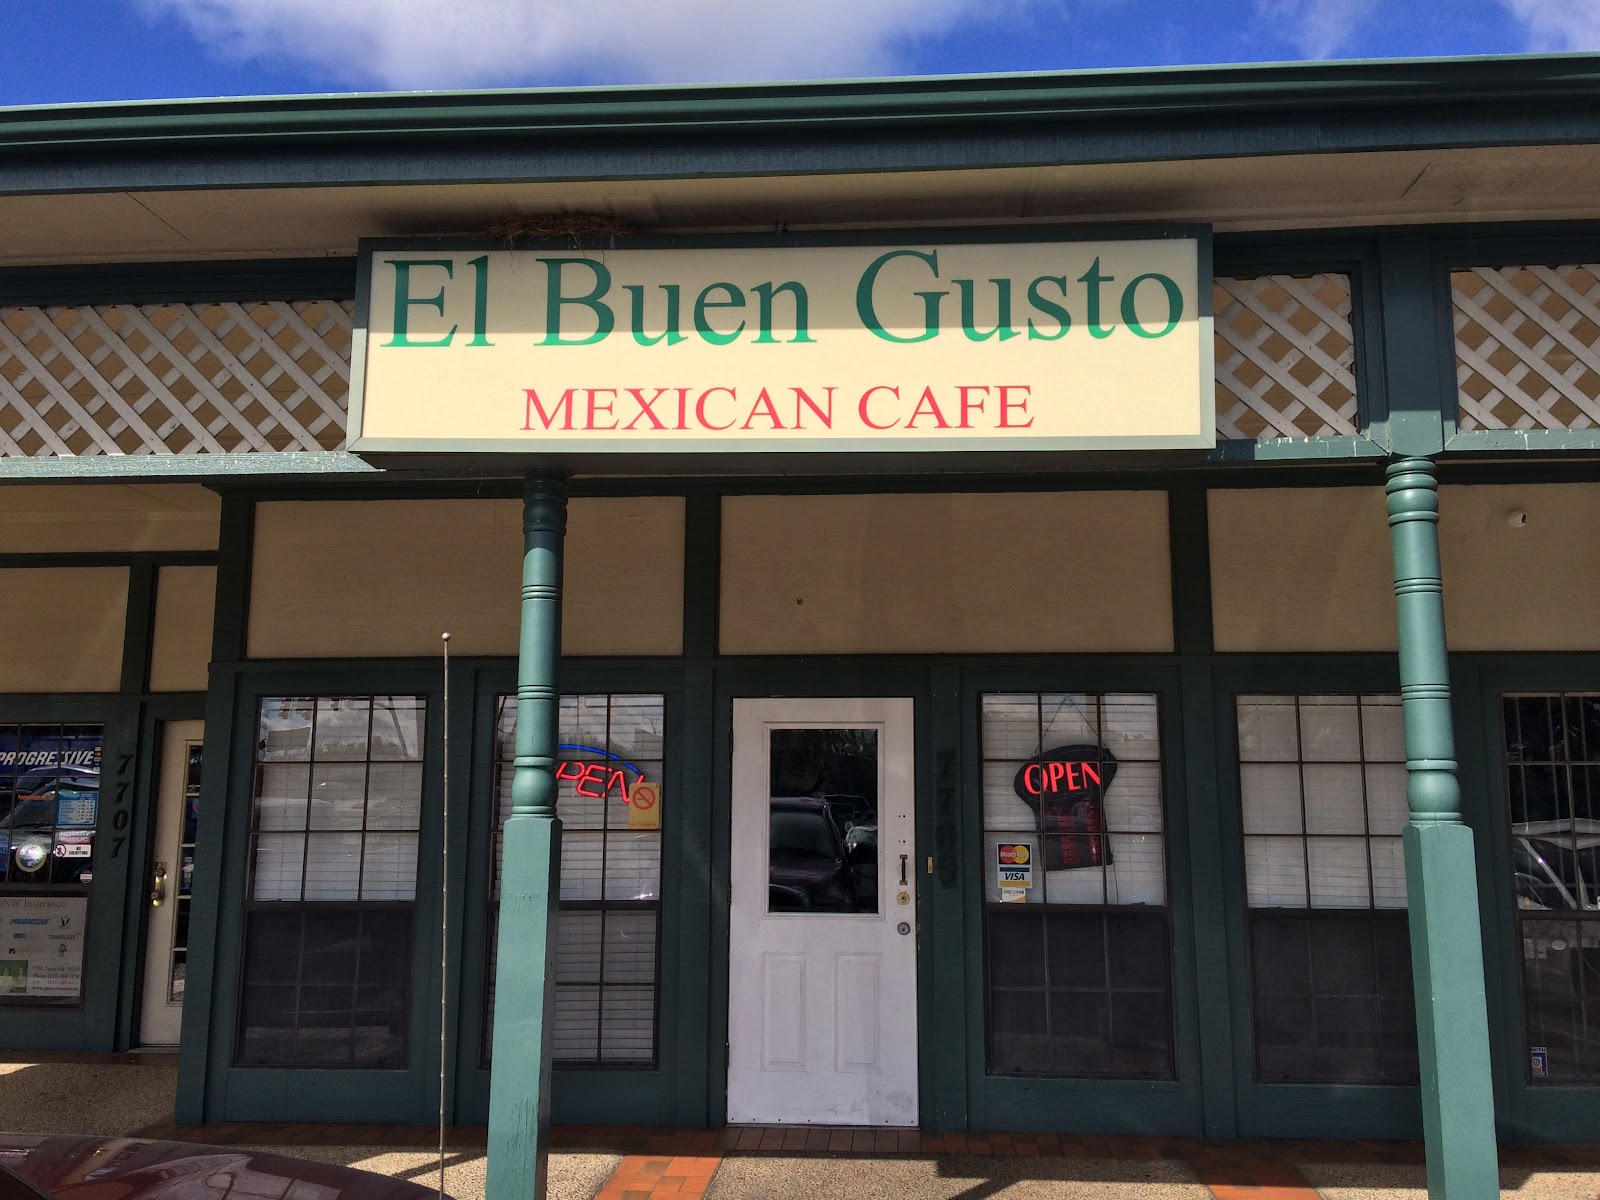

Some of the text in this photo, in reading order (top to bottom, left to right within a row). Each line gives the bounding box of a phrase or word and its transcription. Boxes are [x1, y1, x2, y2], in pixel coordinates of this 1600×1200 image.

[380, 249, 1184, 347] El Buen Gusto
[519, 384, 1035, 432] MEXICAN CAFE
[556, 761, 645, 804] PEN
[1023, 761, 1101, 796] OPEN
[24, 899, 66, 908] Insurance
